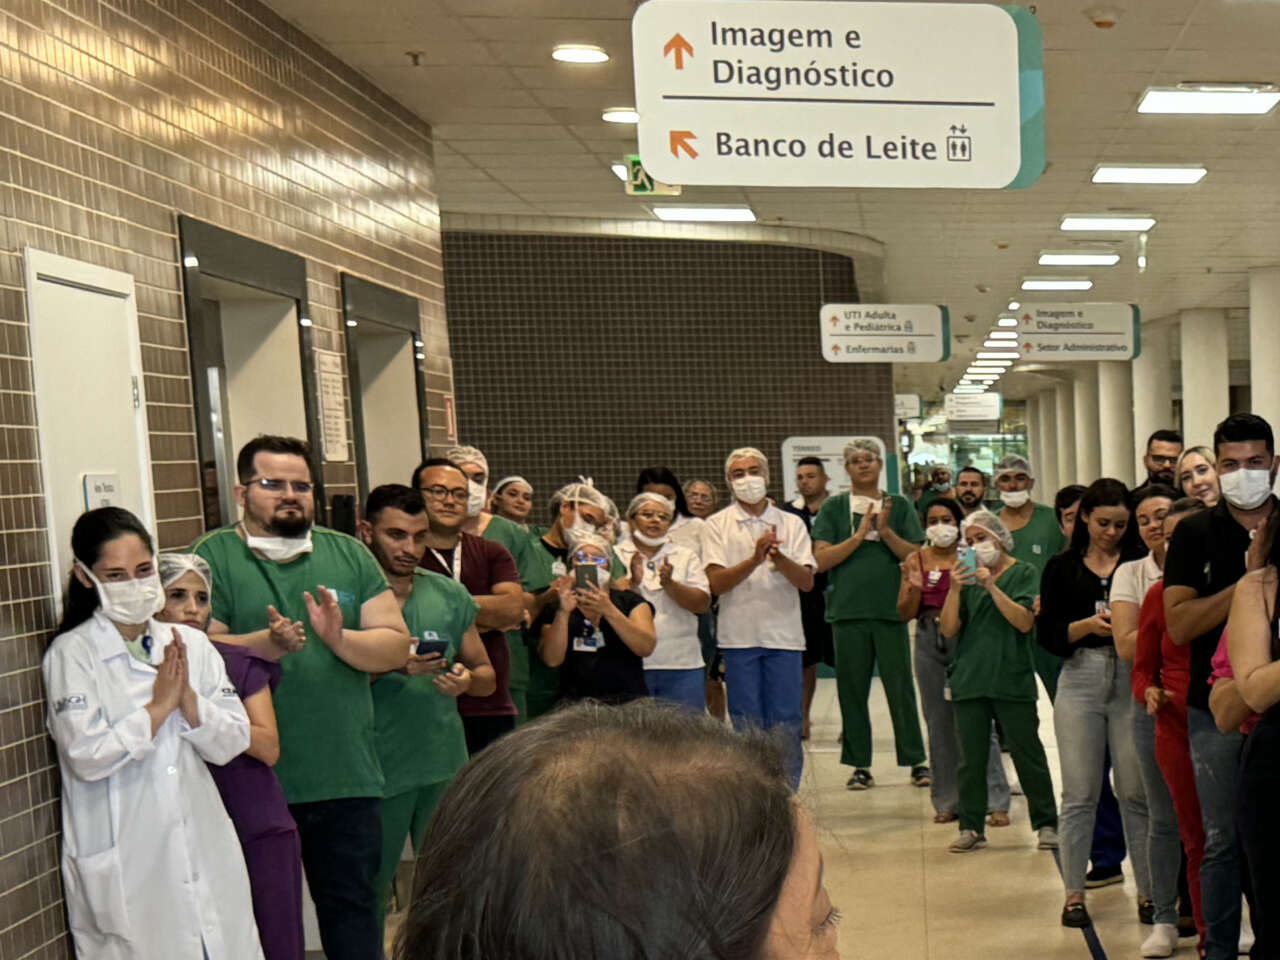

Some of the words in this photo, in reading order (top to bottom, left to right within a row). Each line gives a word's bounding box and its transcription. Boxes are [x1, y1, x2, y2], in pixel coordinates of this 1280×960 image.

[711, 21, 833, 52] Imagem
[845, 28, 861, 49] e
[713, 60, 894, 91] Diagnóstico
[716, 131, 806, 158] Banco
[818, 132, 854, 158] de
[866, 135, 937, 160] Leite
[844, 311, 861, 319] UTI
[846, 345, 904, 354] Enfermarias
